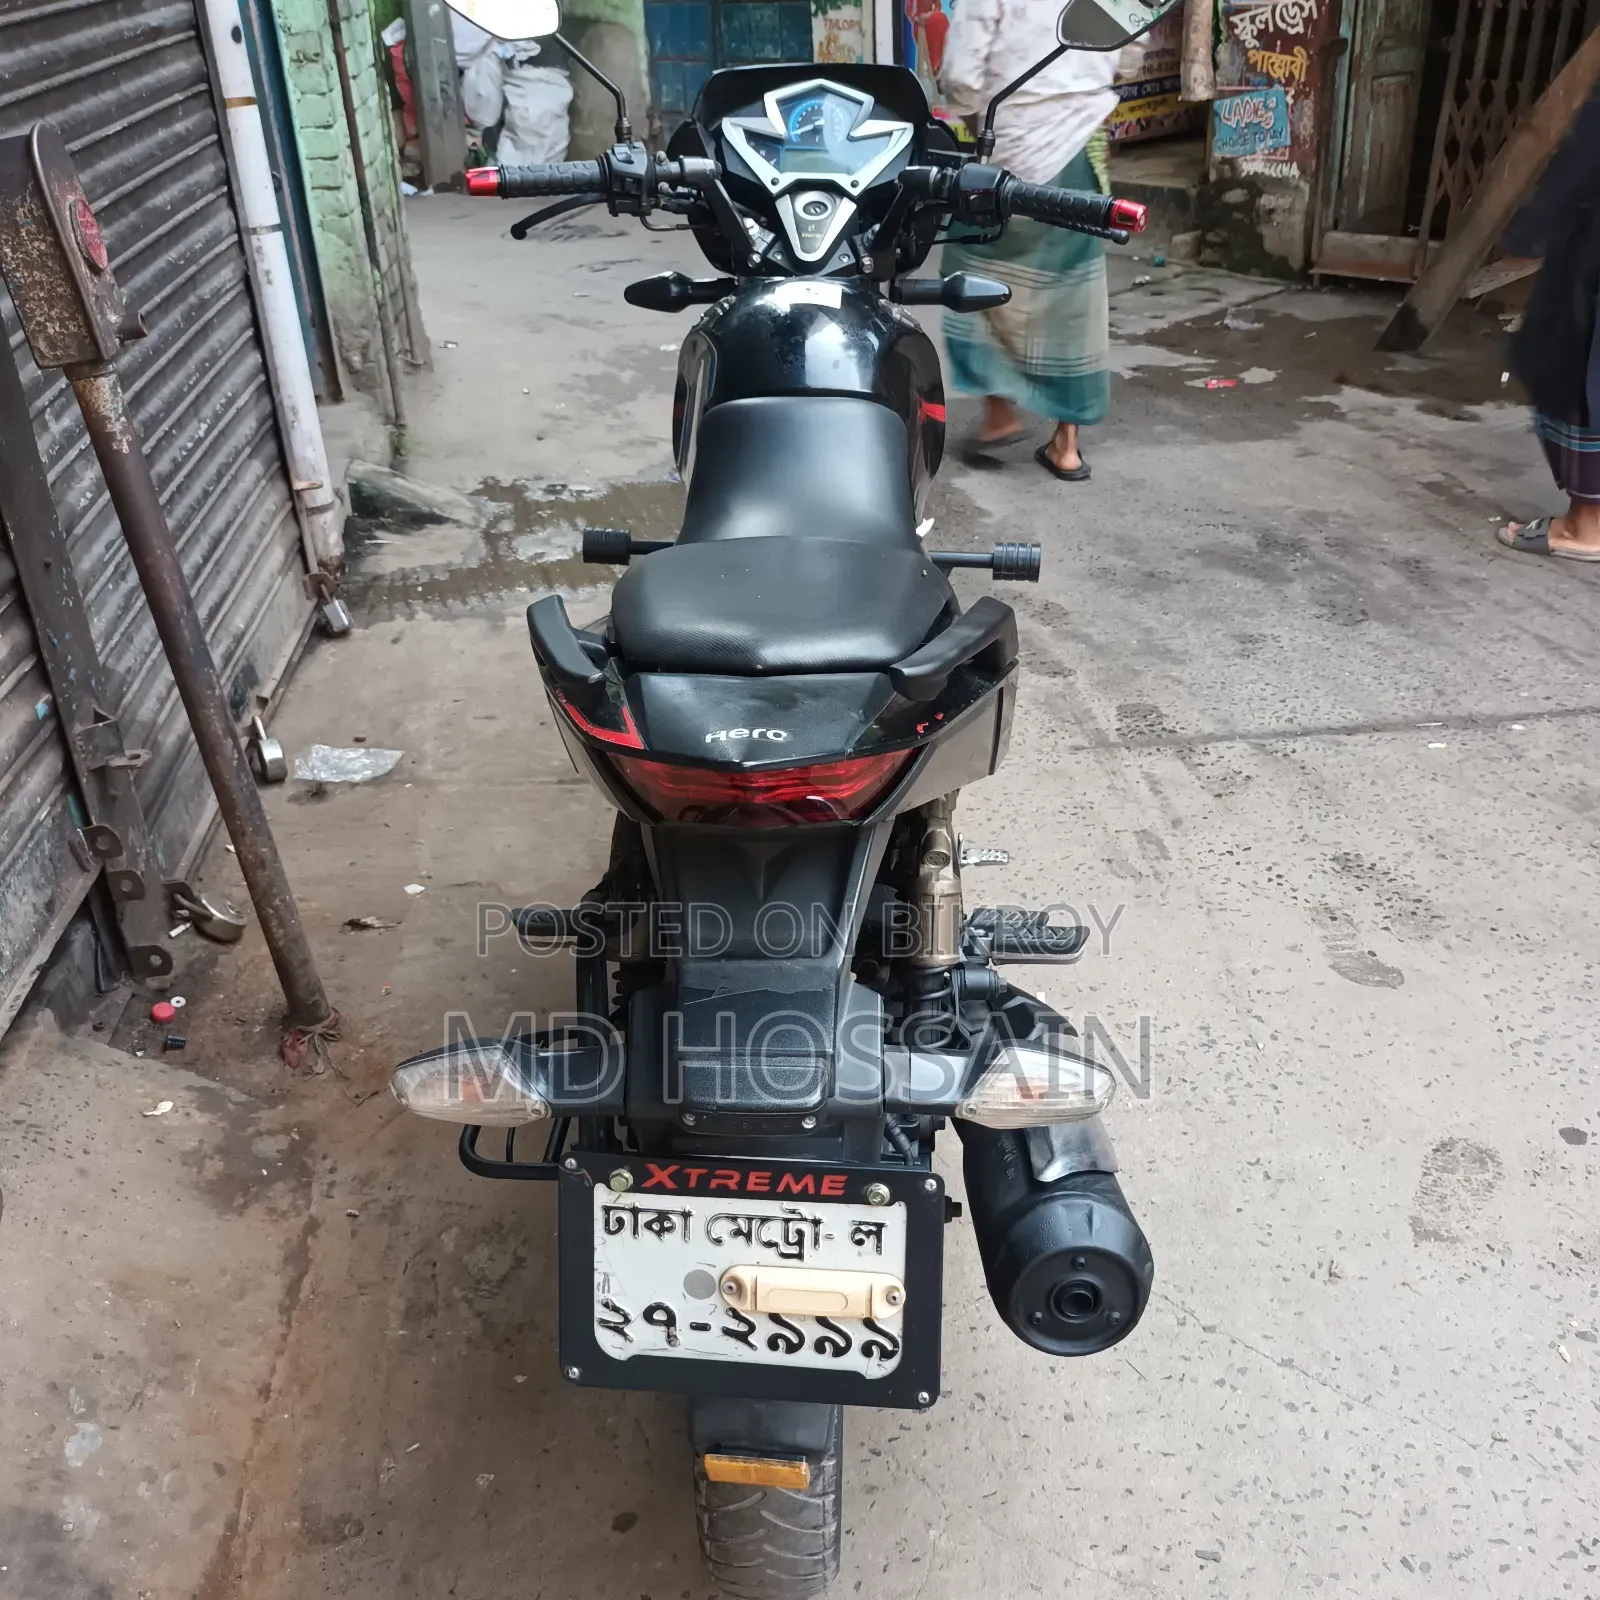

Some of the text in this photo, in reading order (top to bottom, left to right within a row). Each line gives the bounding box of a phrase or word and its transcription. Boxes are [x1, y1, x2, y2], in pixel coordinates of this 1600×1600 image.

[1229, 5, 1274, 48] স্কুল
[641, 1163, 849, 1196] XTREME
[602, 1203, 693, 1244] ঢাকা
[849, 1218, 889, 1256] ল
